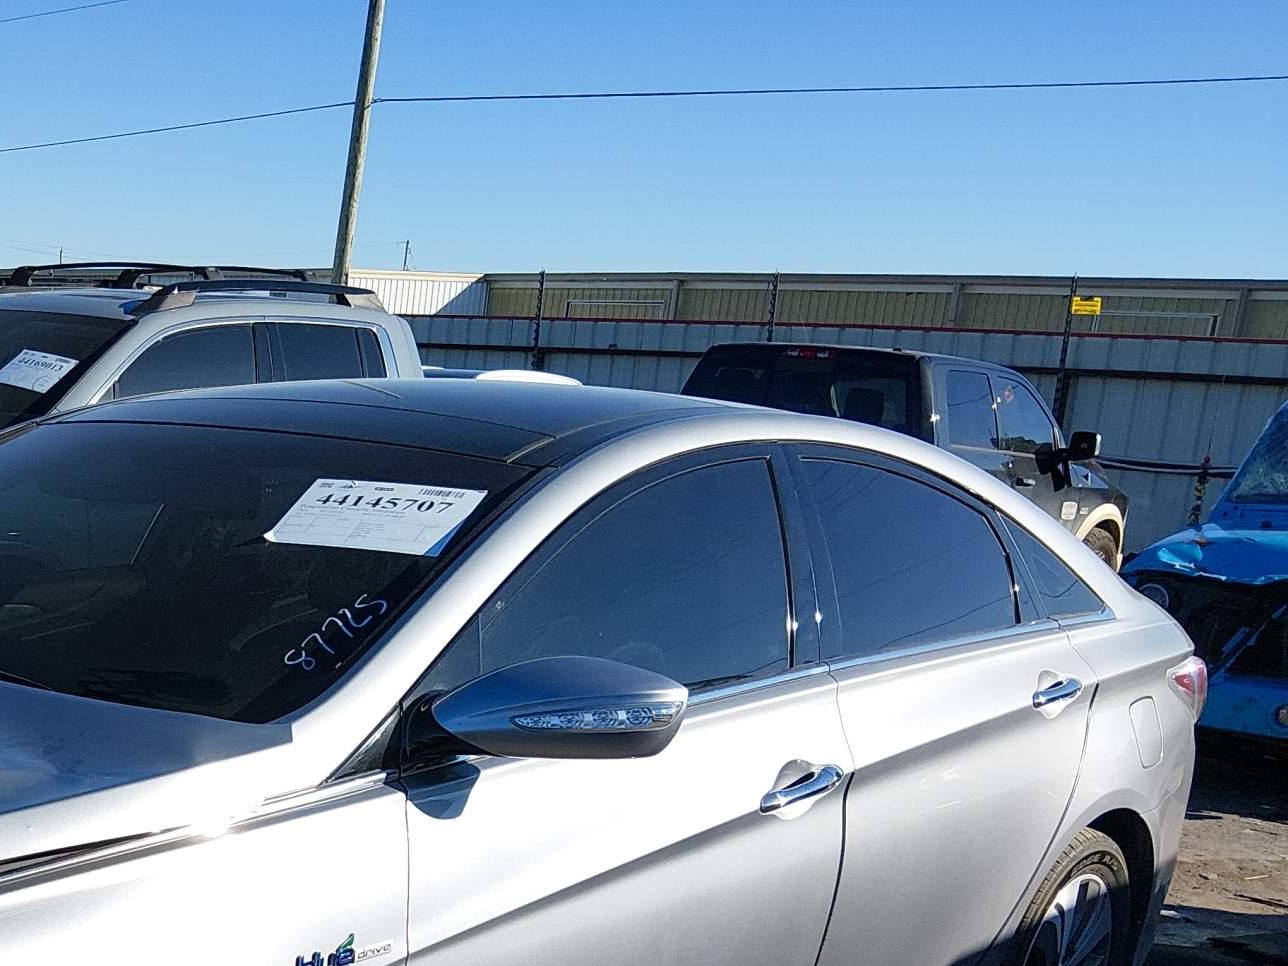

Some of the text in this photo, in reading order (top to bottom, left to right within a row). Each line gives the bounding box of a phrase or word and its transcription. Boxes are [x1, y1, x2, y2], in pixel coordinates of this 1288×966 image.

[18, 357, 64, 372] 44169013
[316, 493, 454, 514] 44145707
[284, 593, 387, 671] 87725
[357, 943, 392, 960] drive
